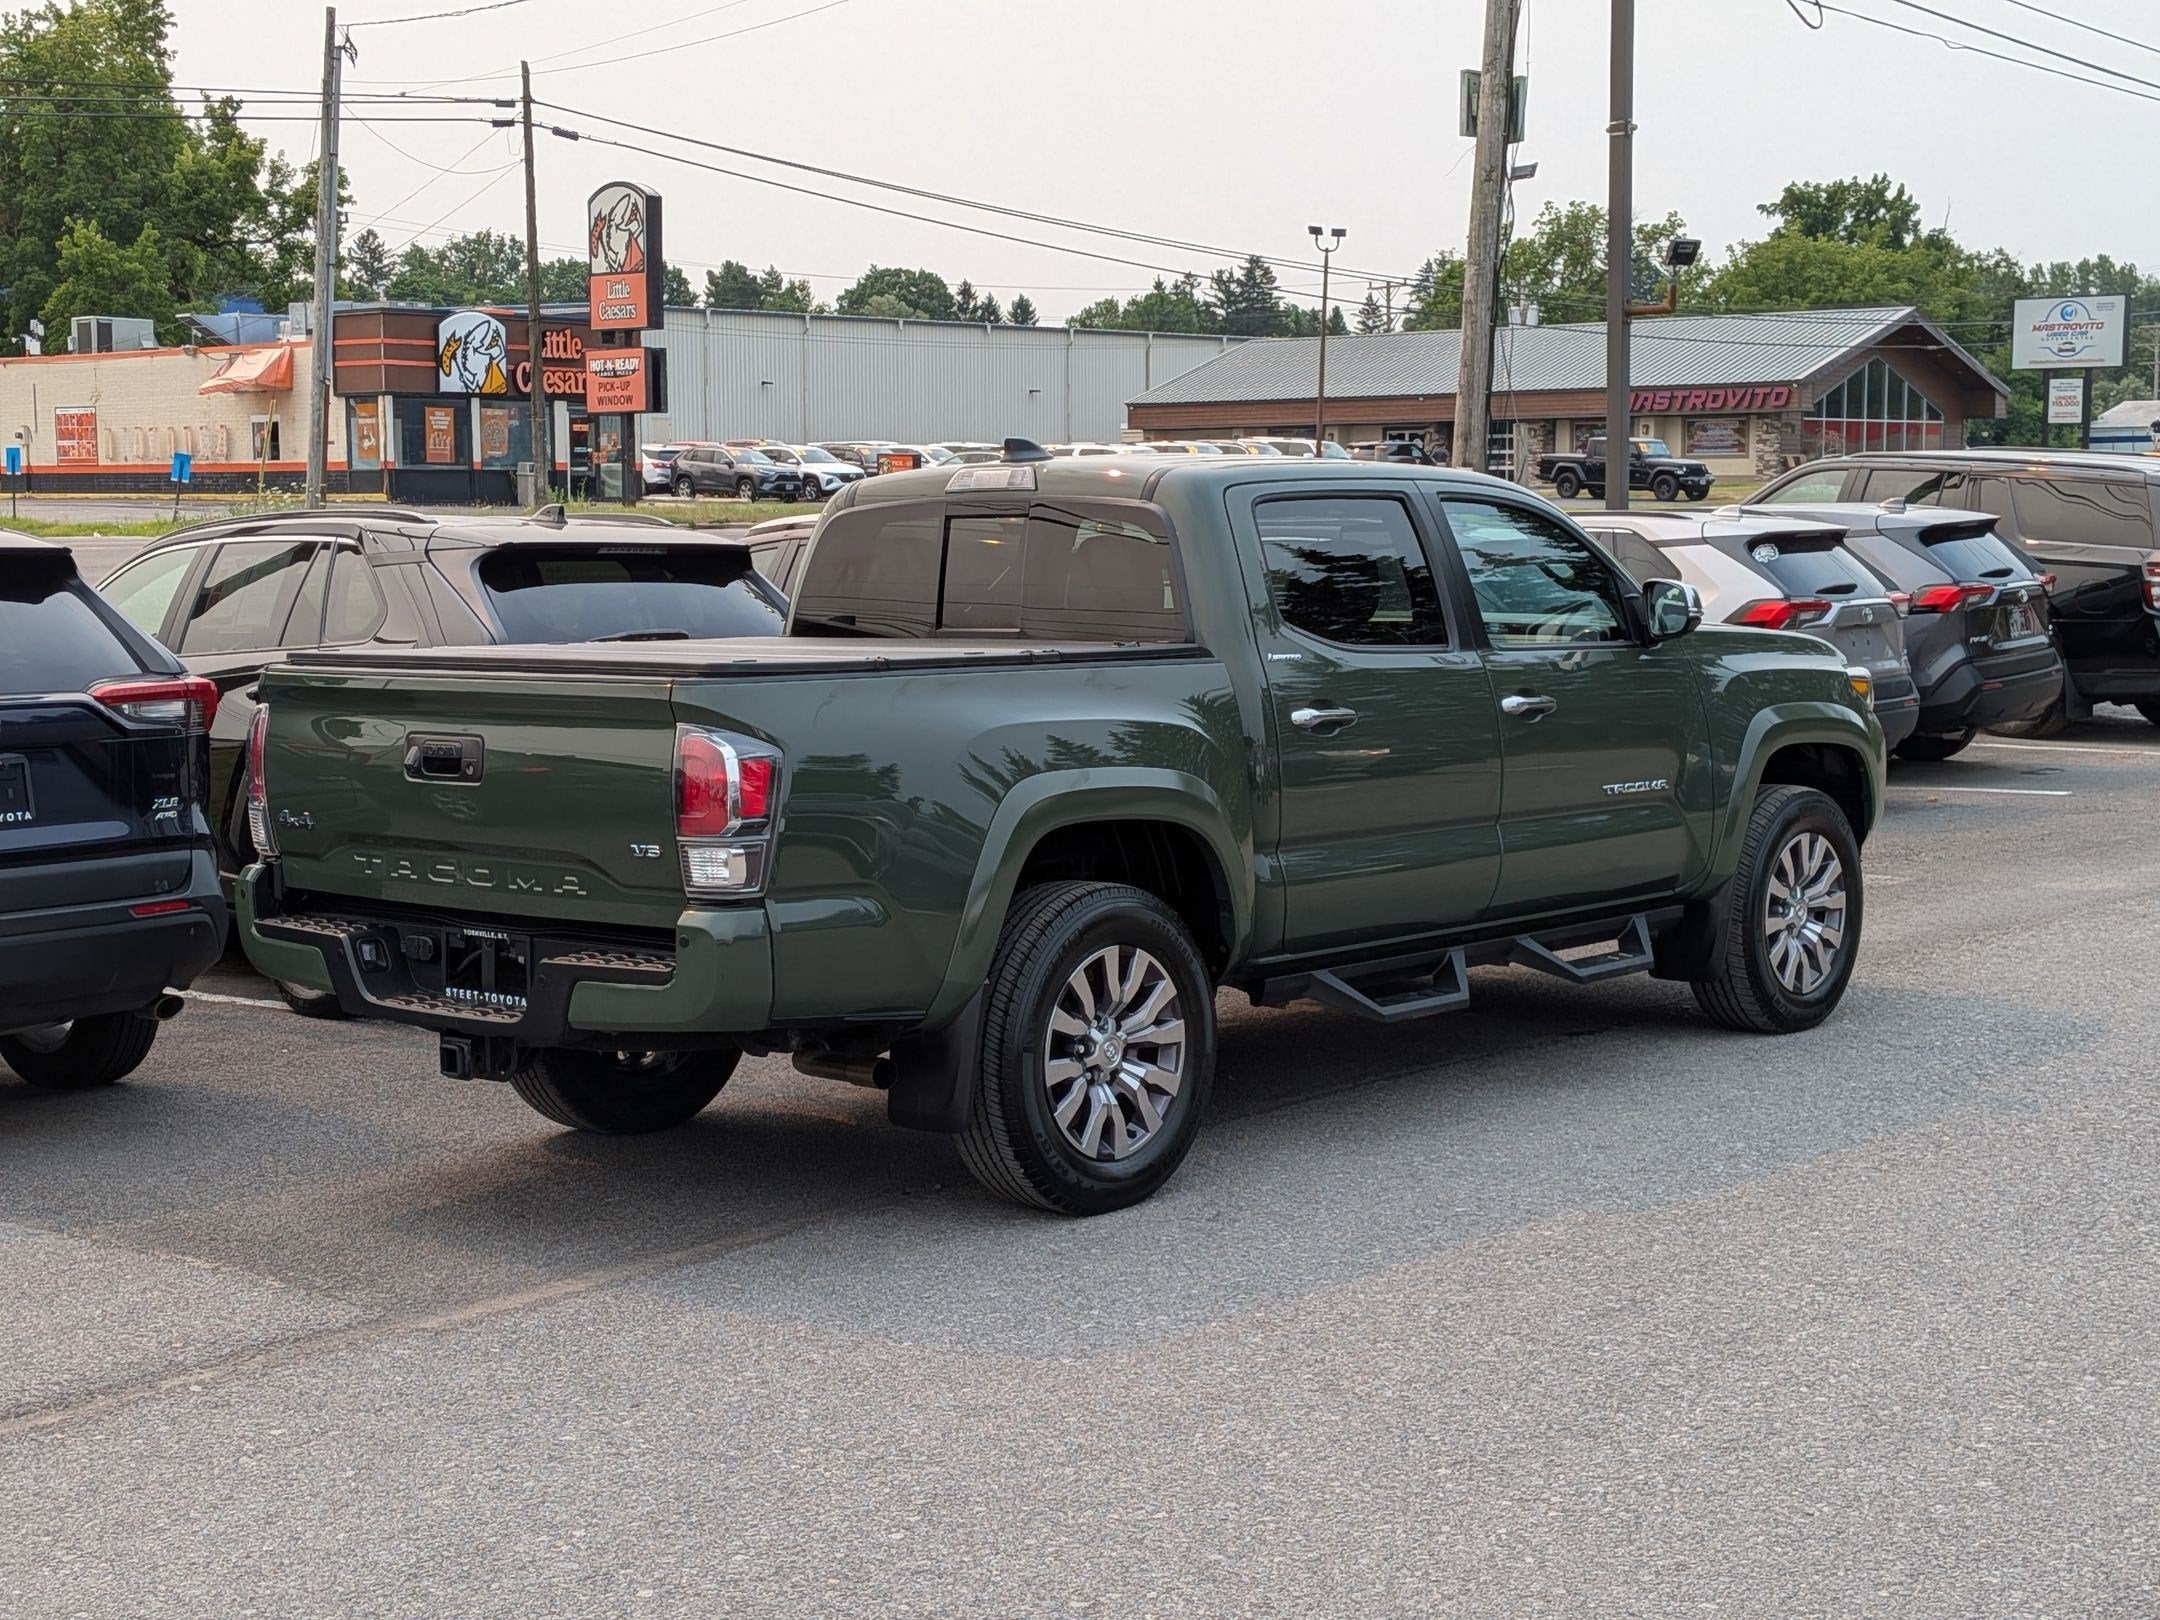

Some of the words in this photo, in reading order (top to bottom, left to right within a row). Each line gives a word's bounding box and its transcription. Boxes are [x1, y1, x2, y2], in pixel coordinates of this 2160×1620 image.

[606, 280, 631, 299] Little
[598, 301, 637, 320] Caesars
[2031, 322, 2105, 332] MASTROVITO
[542, 328, 582, 359] ittle
[590, 357, 640, 371] HOT-N-READY
[516, 361, 586, 394] Cesar
[598, 381, 631, 392] PICK-UP
[597, 394, 633, 406] WINDOW
[352, 853, 588, 895] TACOMA
